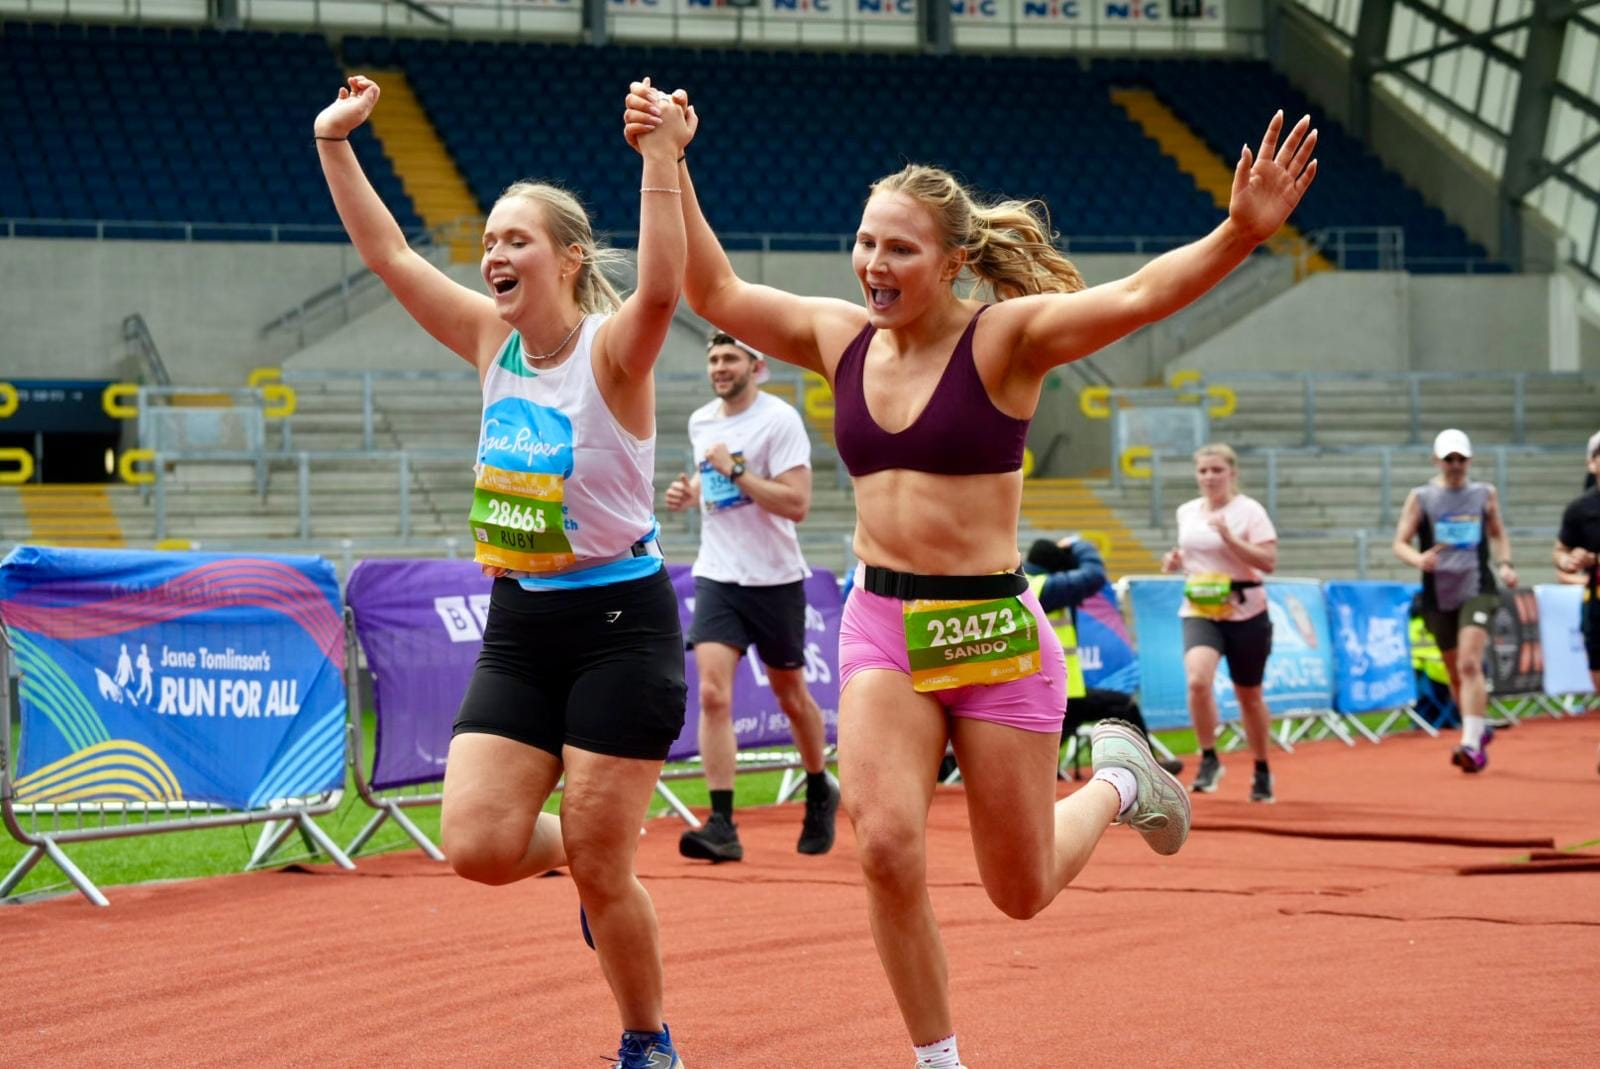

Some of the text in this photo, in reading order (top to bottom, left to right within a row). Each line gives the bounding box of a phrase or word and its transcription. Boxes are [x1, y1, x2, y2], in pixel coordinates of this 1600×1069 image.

[485, 498, 546, 533] 28665
[500, 530, 535, 549] RUBY
[927, 608, 1017, 648] 23473
[160, 645, 271, 672] Jane Tomlinson's
[944, 640, 1007, 661] SANDO
[157, 677, 300, 718] RUN FOR ALL
